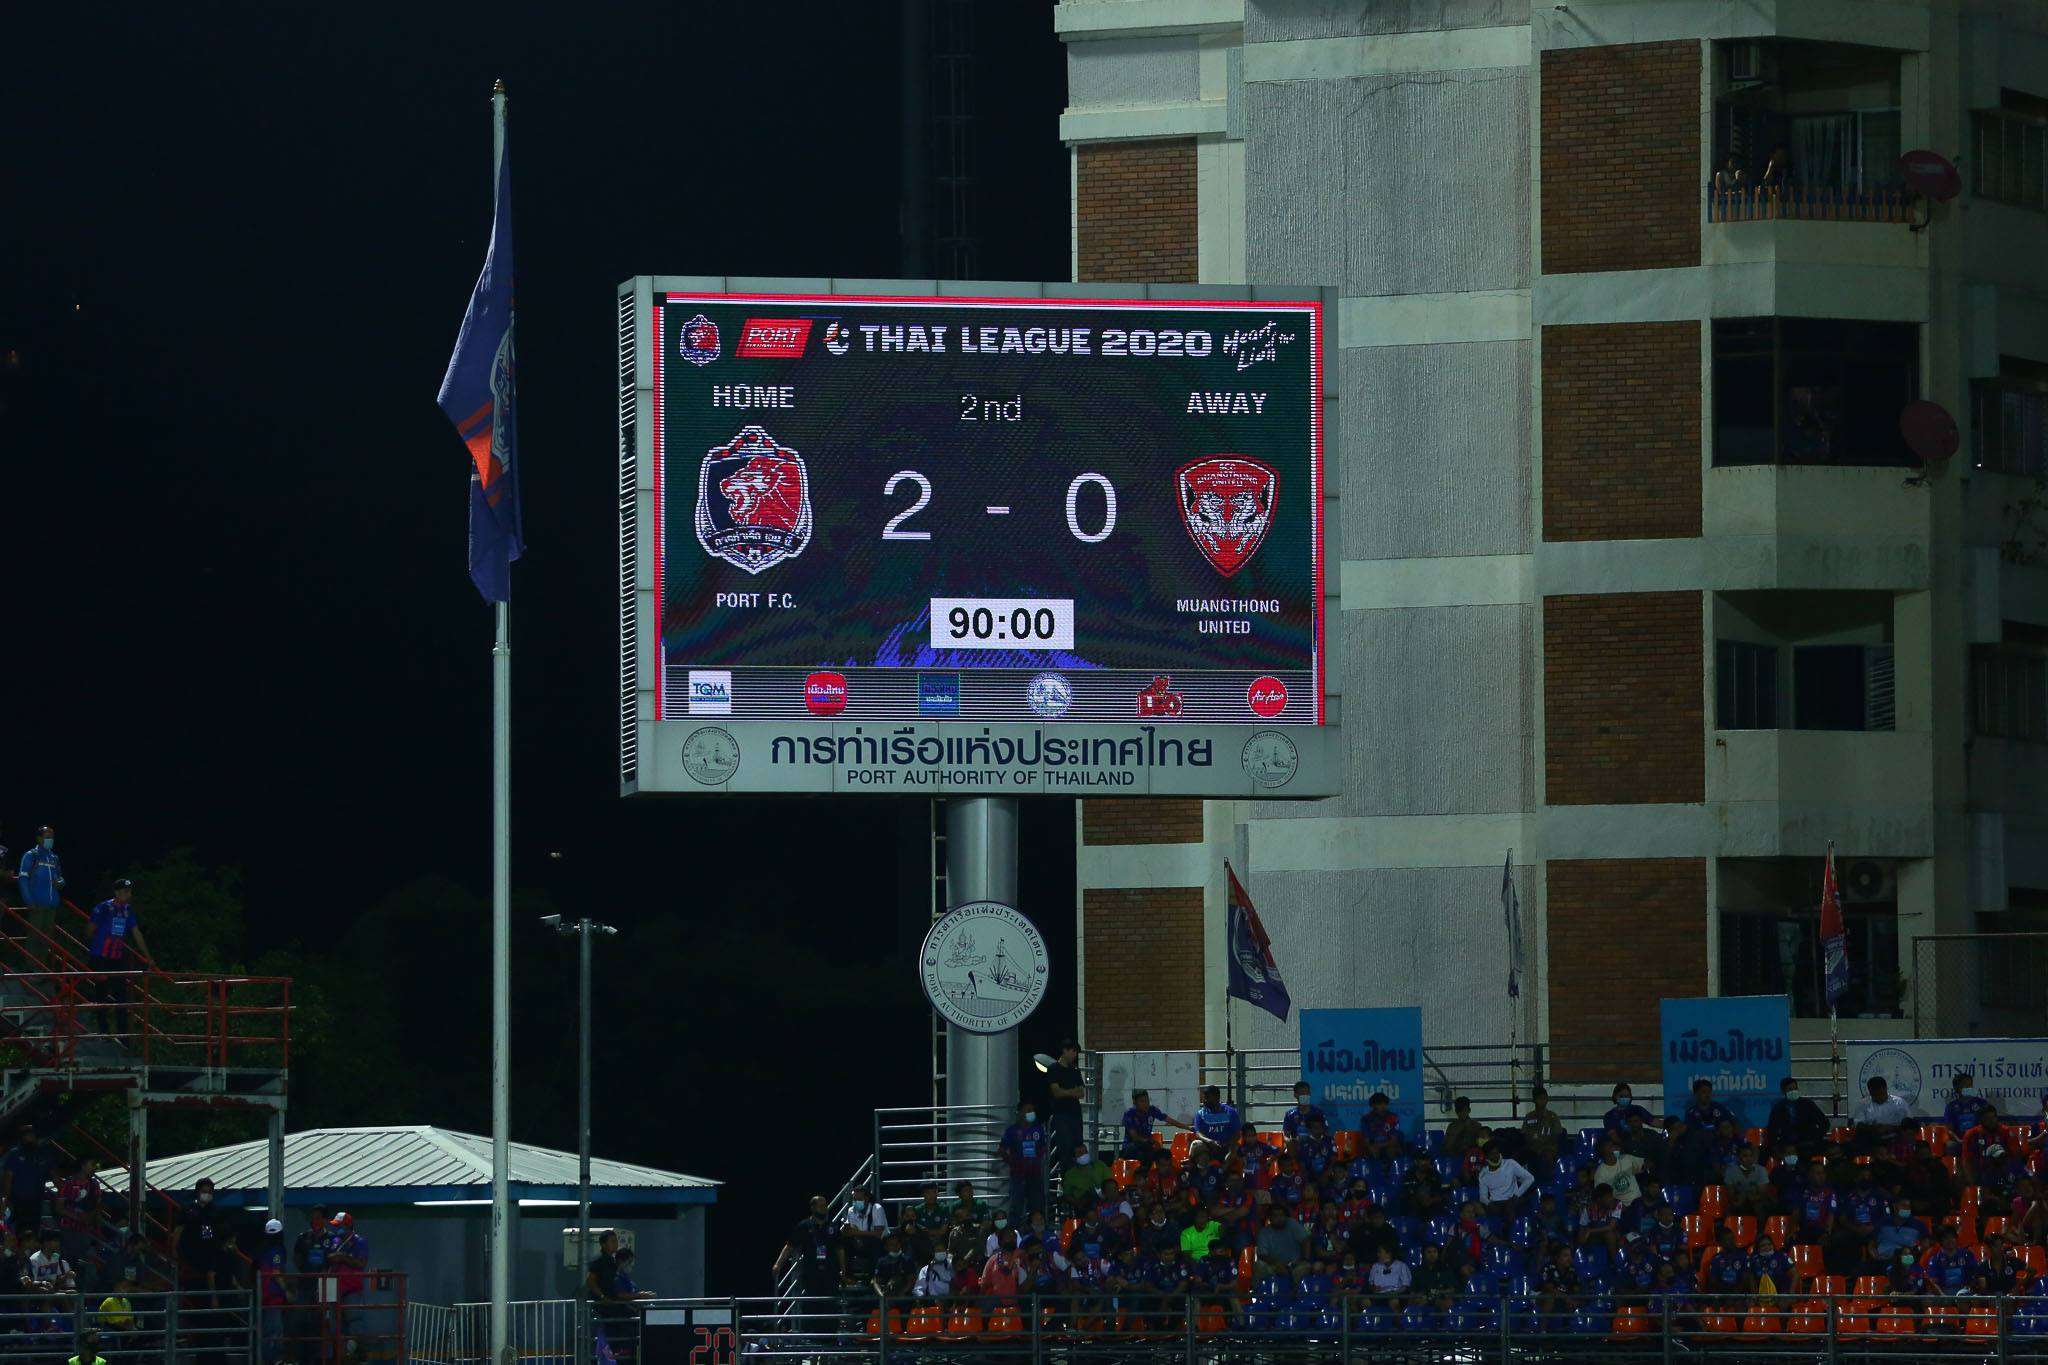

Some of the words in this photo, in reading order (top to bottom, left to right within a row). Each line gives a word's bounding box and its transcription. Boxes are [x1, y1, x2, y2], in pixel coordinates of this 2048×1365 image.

[748, 327, 802, 343] PORT
[859, 325, 948, 353] THAI
[960, 327, 1092, 355] LEAGUE
[1101, 329, 1213, 357] 2020
[713, 383, 795, 410] HOME
[960, 393, 1022, 421] 2nd
[1186, 392, 1268, 414] AWAY
[881, 470, 933, 540] 2
[1065, 472, 1118, 543] 0
[716, 591, 761, 608] PORT
[767, 591, 798, 608] F.C.
[1176, 598, 1281, 614] MUANGTHONG
[948, 606, 1056, 640] 90:00
[1198, 620, 1251, 634] UNITED
[692, 682, 726, 696] TQM
[771, 726, 1213, 767] การท่าเรือแห่งประเทศไทย
[847, 769, 896, 785] PORT
[903, 769, 1006, 786] AUTHORITY
[1013, 770, 1037, 785] OF
[1043, 771, 1135, 786] THAILAND
[927, 973, 942, 1000] PORT
[941, 1001, 993, 1028] AUTHORITY
[997, 1018, 1009, 1027] OF
[1013, 978, 1043, 1019] THAILAND
[1307, 1038, 1416, 1073] เมืองไทย
[1669, 1027, 1782, 1063] เมืองไทย
[1932, 1056, 2048, 1078] การท่าเรือแห่
[689, 1327, 735, 1365] 20
